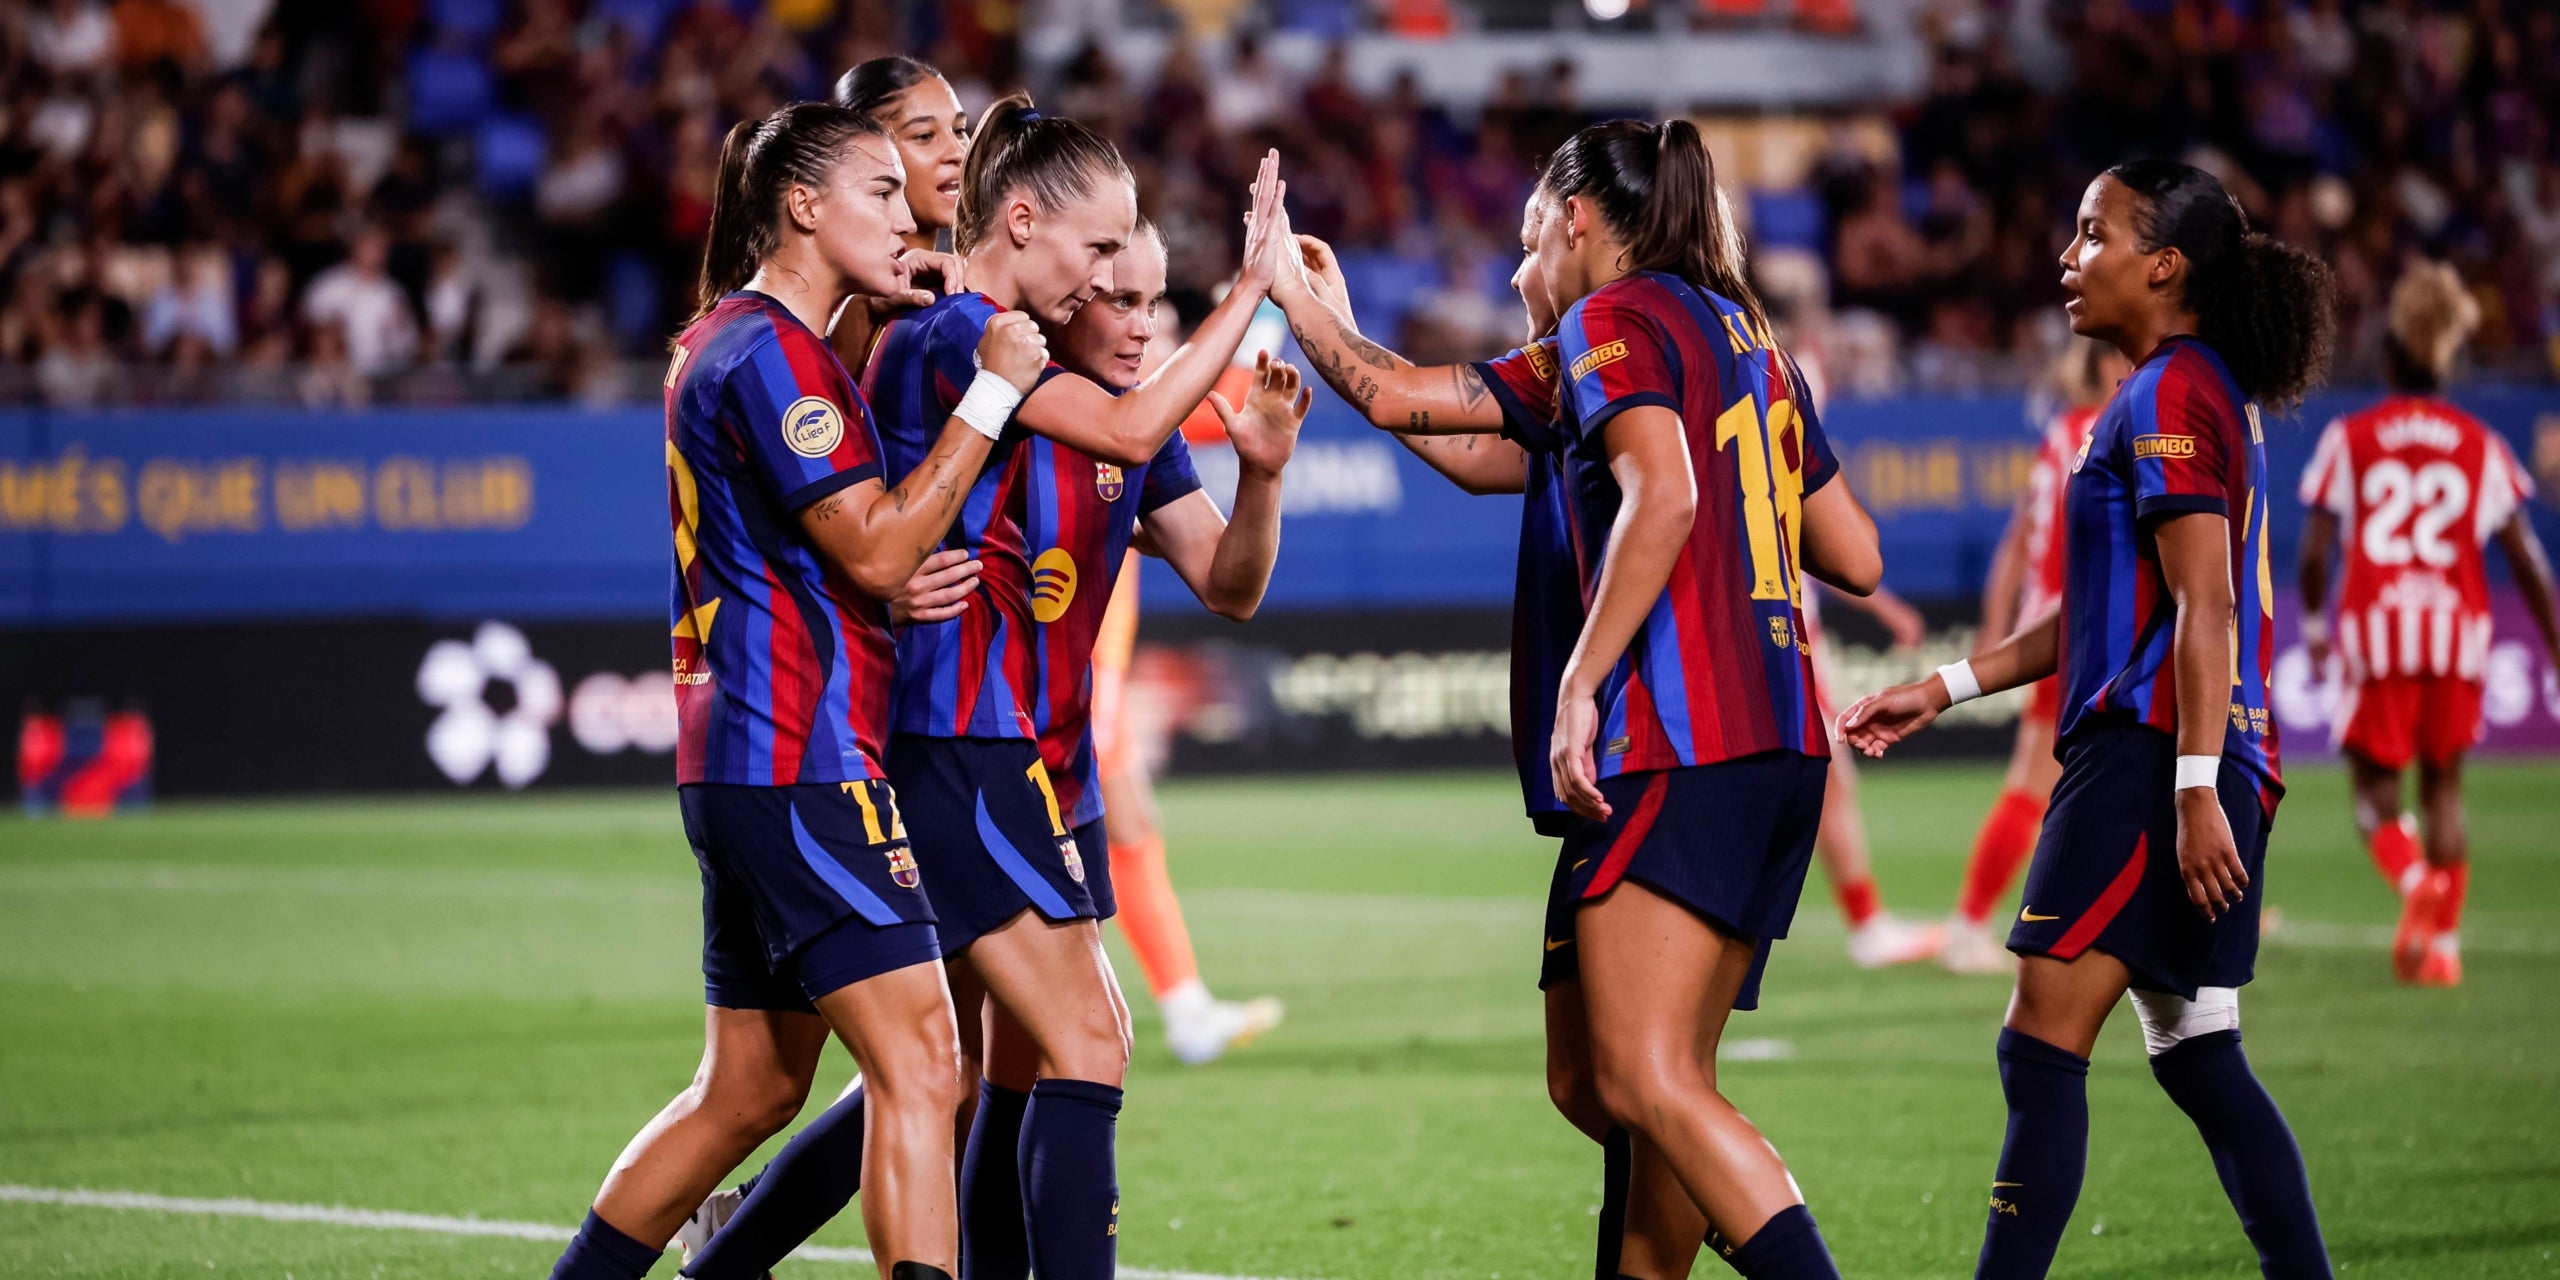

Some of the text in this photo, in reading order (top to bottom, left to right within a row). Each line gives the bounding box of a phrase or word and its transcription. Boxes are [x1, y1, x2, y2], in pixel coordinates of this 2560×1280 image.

[1520, 342, 1555, 379] MBO
[1570, 342, 1627, 381] BIMBO
[801, 421, 831, 441] Liga F
[2133, 438, 2194, 456] BIMBO
[138, 457, 262, 546] QUE
[274, 457, 366, 533] UN
[376, 455, 533, 532] CLUB
[1715, 392, 1804, 610] 18
[2362, 458, 2470, 569] 22
